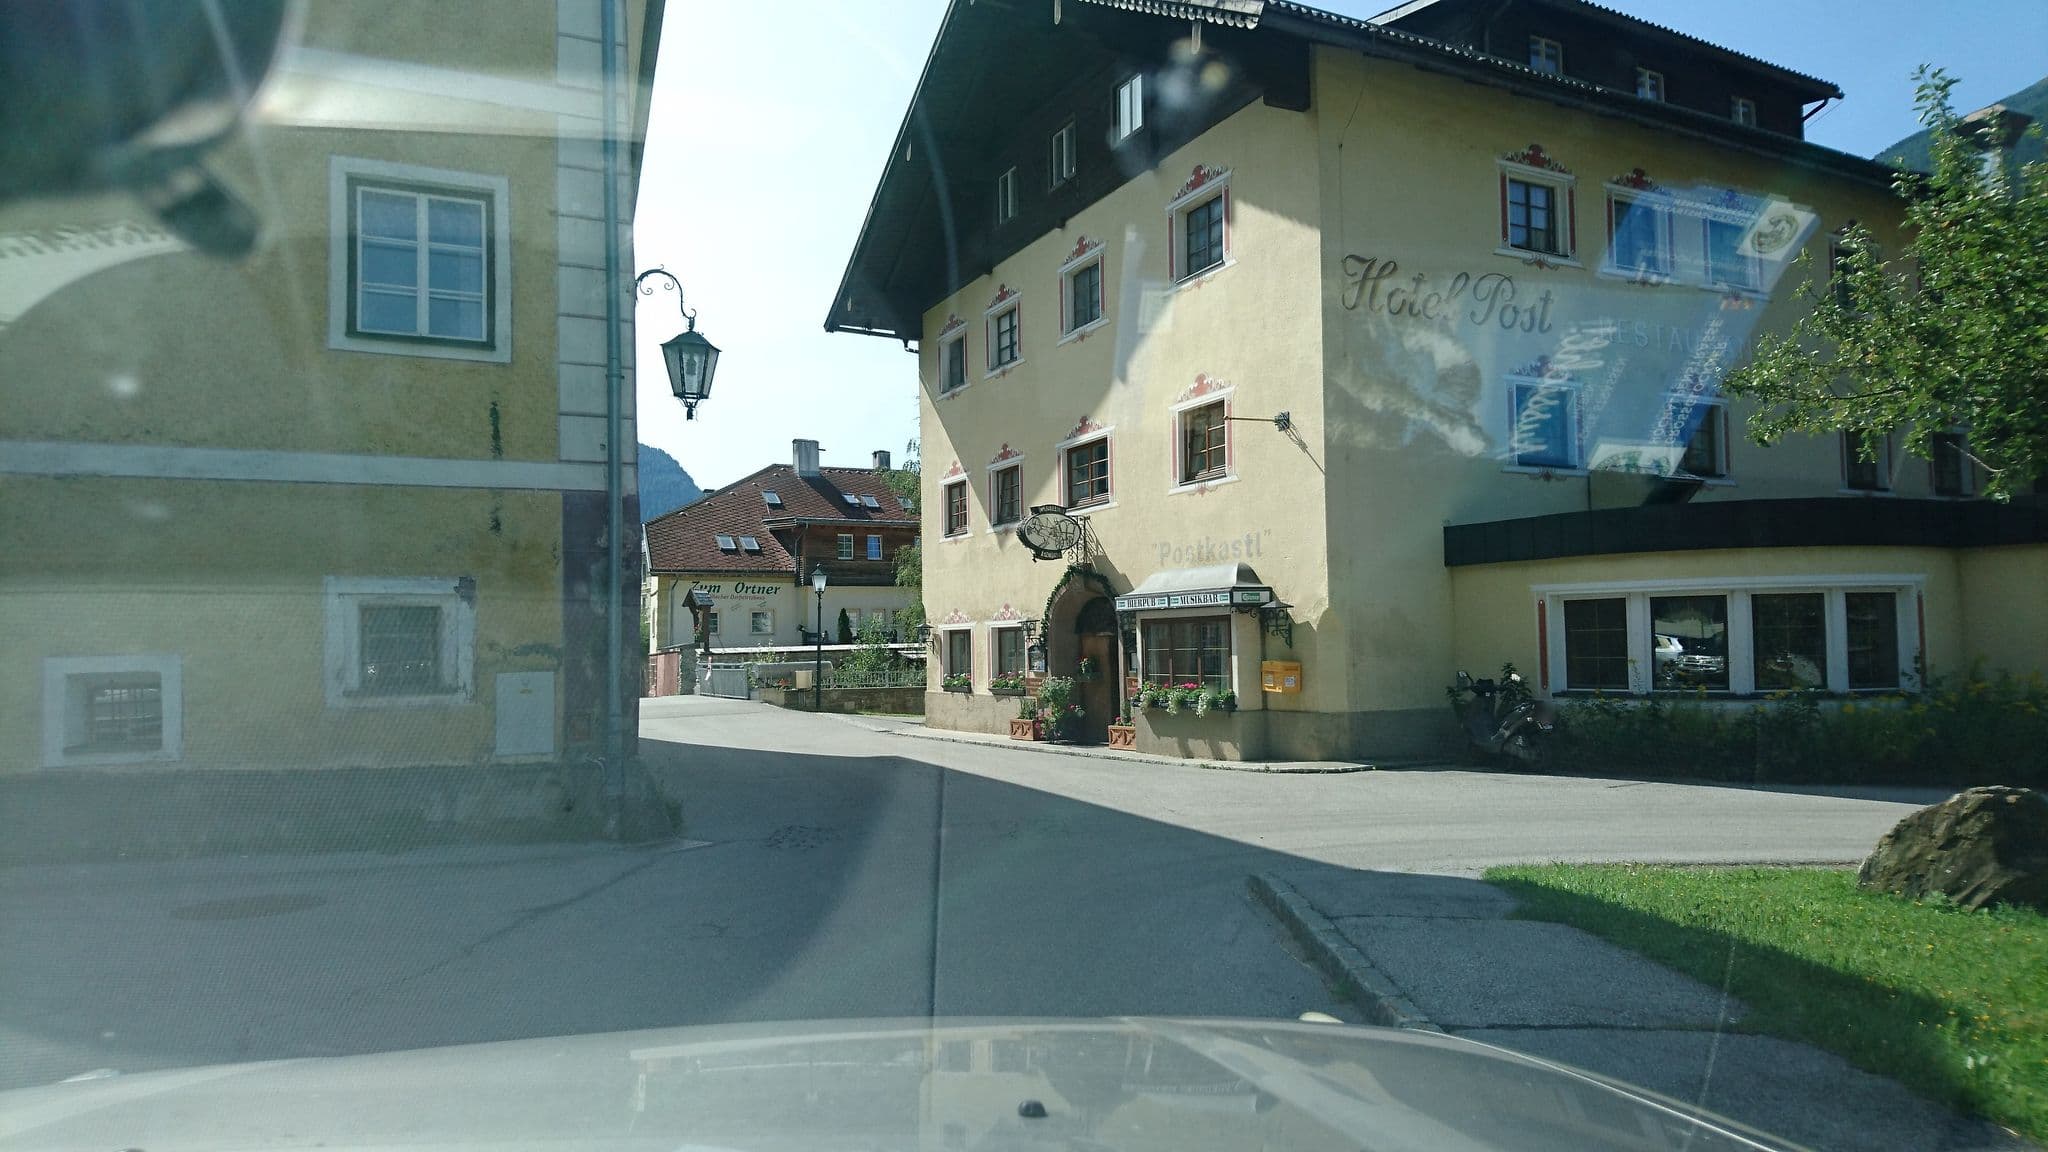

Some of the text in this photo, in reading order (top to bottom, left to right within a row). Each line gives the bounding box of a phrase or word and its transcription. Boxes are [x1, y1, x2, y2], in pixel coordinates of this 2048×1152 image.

[1341, 254, 1555, 334] Hotel Post
[692, 581, 781, 595] Zum Ortner
[1180, 594, 1219, 605] MUSIKBAR
